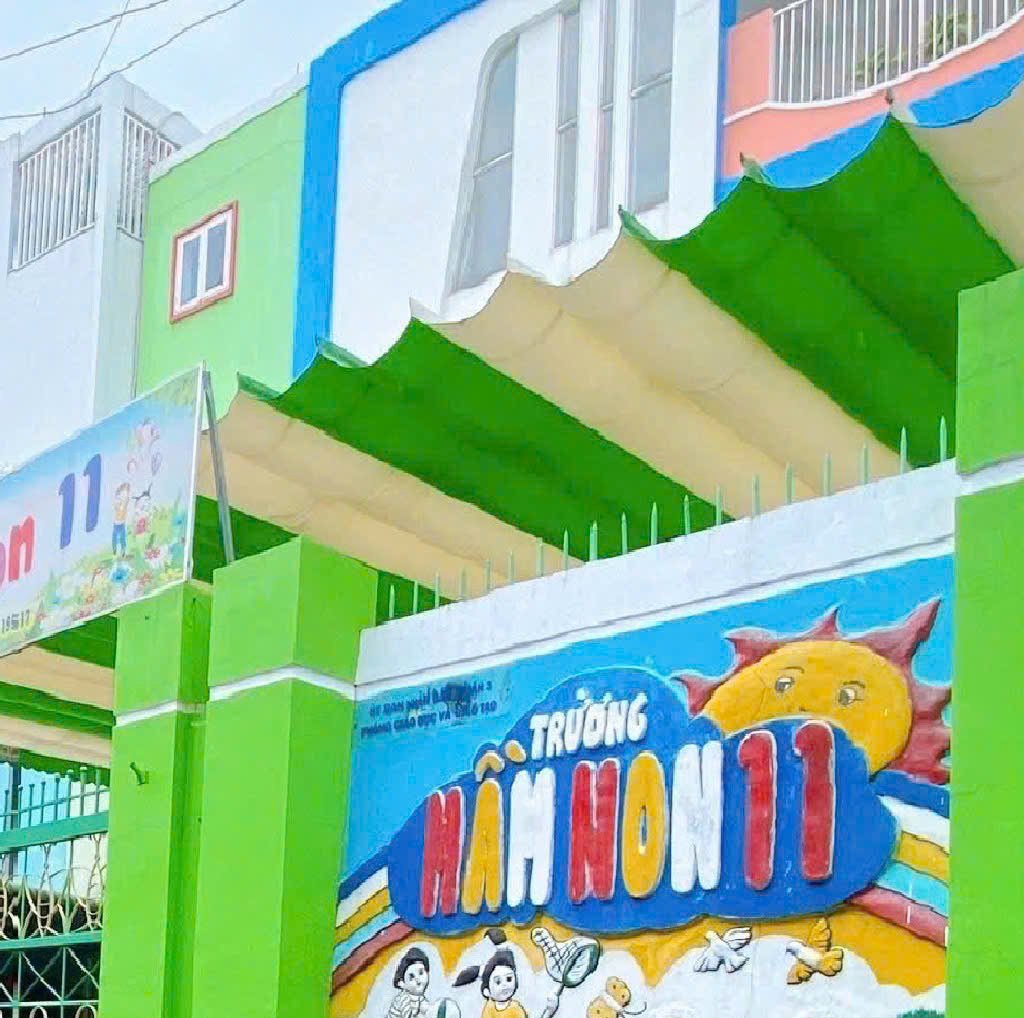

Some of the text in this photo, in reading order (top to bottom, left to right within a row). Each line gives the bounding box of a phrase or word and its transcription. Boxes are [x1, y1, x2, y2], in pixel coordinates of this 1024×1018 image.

[58, 453, 102, 549] 11
[530, 688, 648, 761] TRƯỜNG
[570, 740, 724, 906] NON
[739, 719, 836, 891] 11
